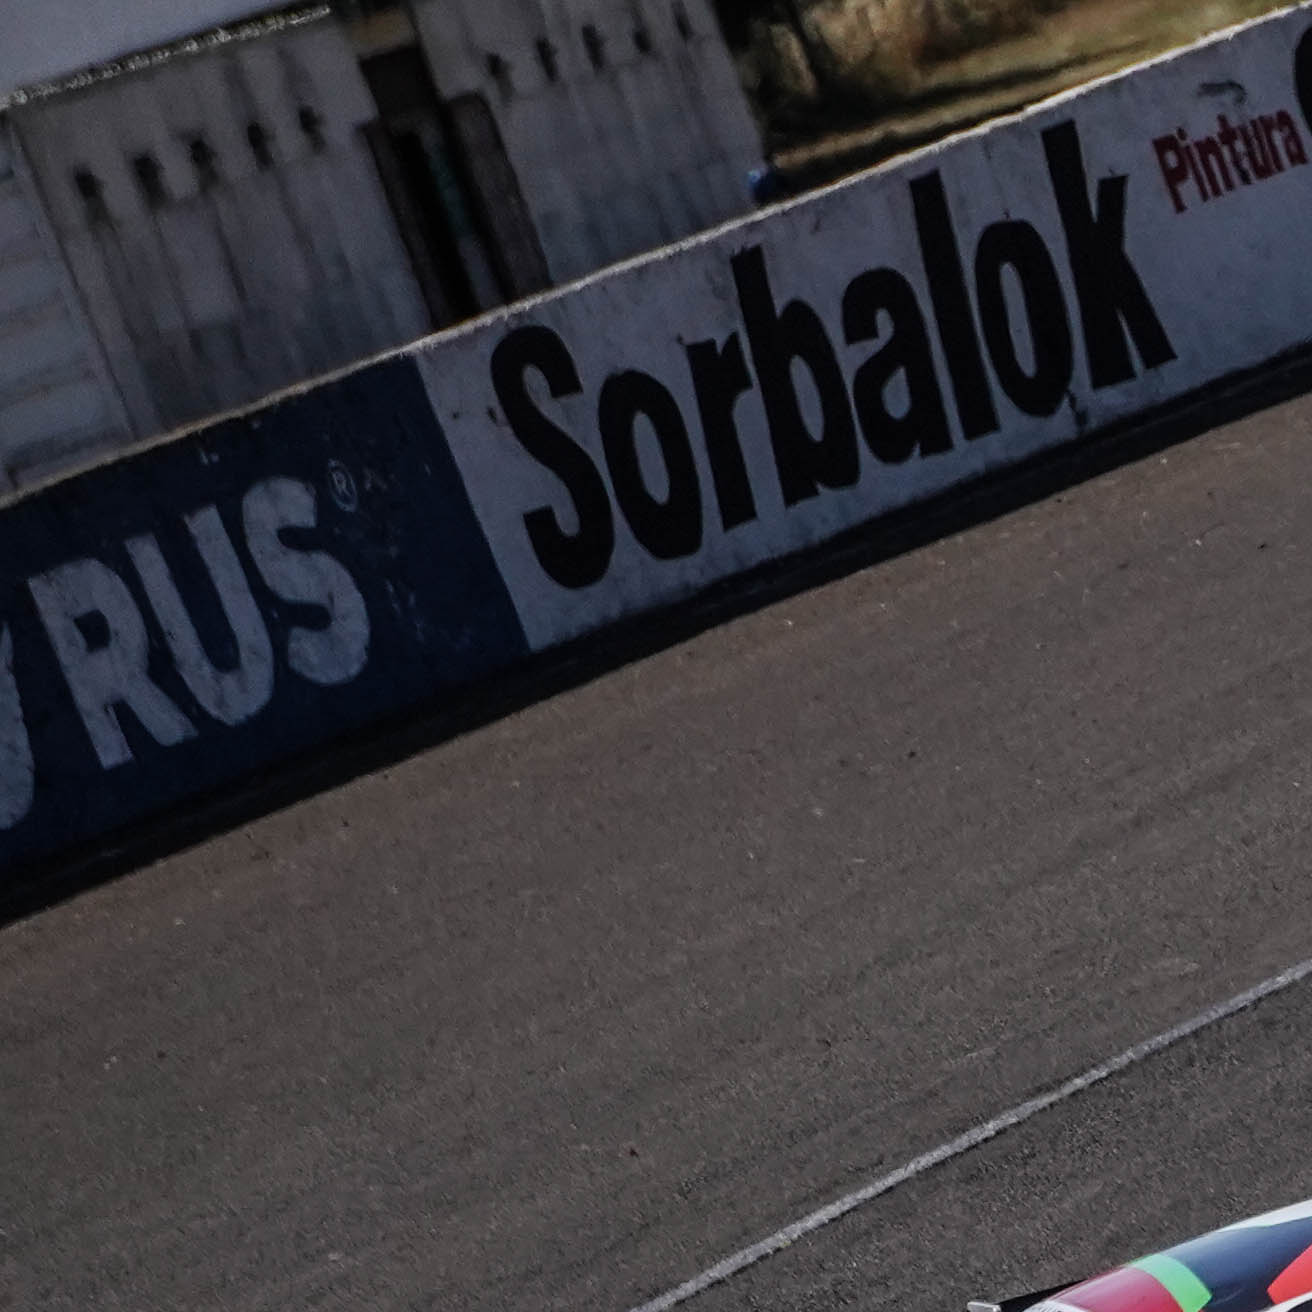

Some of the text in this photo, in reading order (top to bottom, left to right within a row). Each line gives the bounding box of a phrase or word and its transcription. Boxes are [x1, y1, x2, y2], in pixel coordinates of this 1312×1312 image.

[1151, 108, 1309, 214] Pintura
[490, 120, 1177, 590] Sorbalok
[28, 475, 371, 771] RUS
